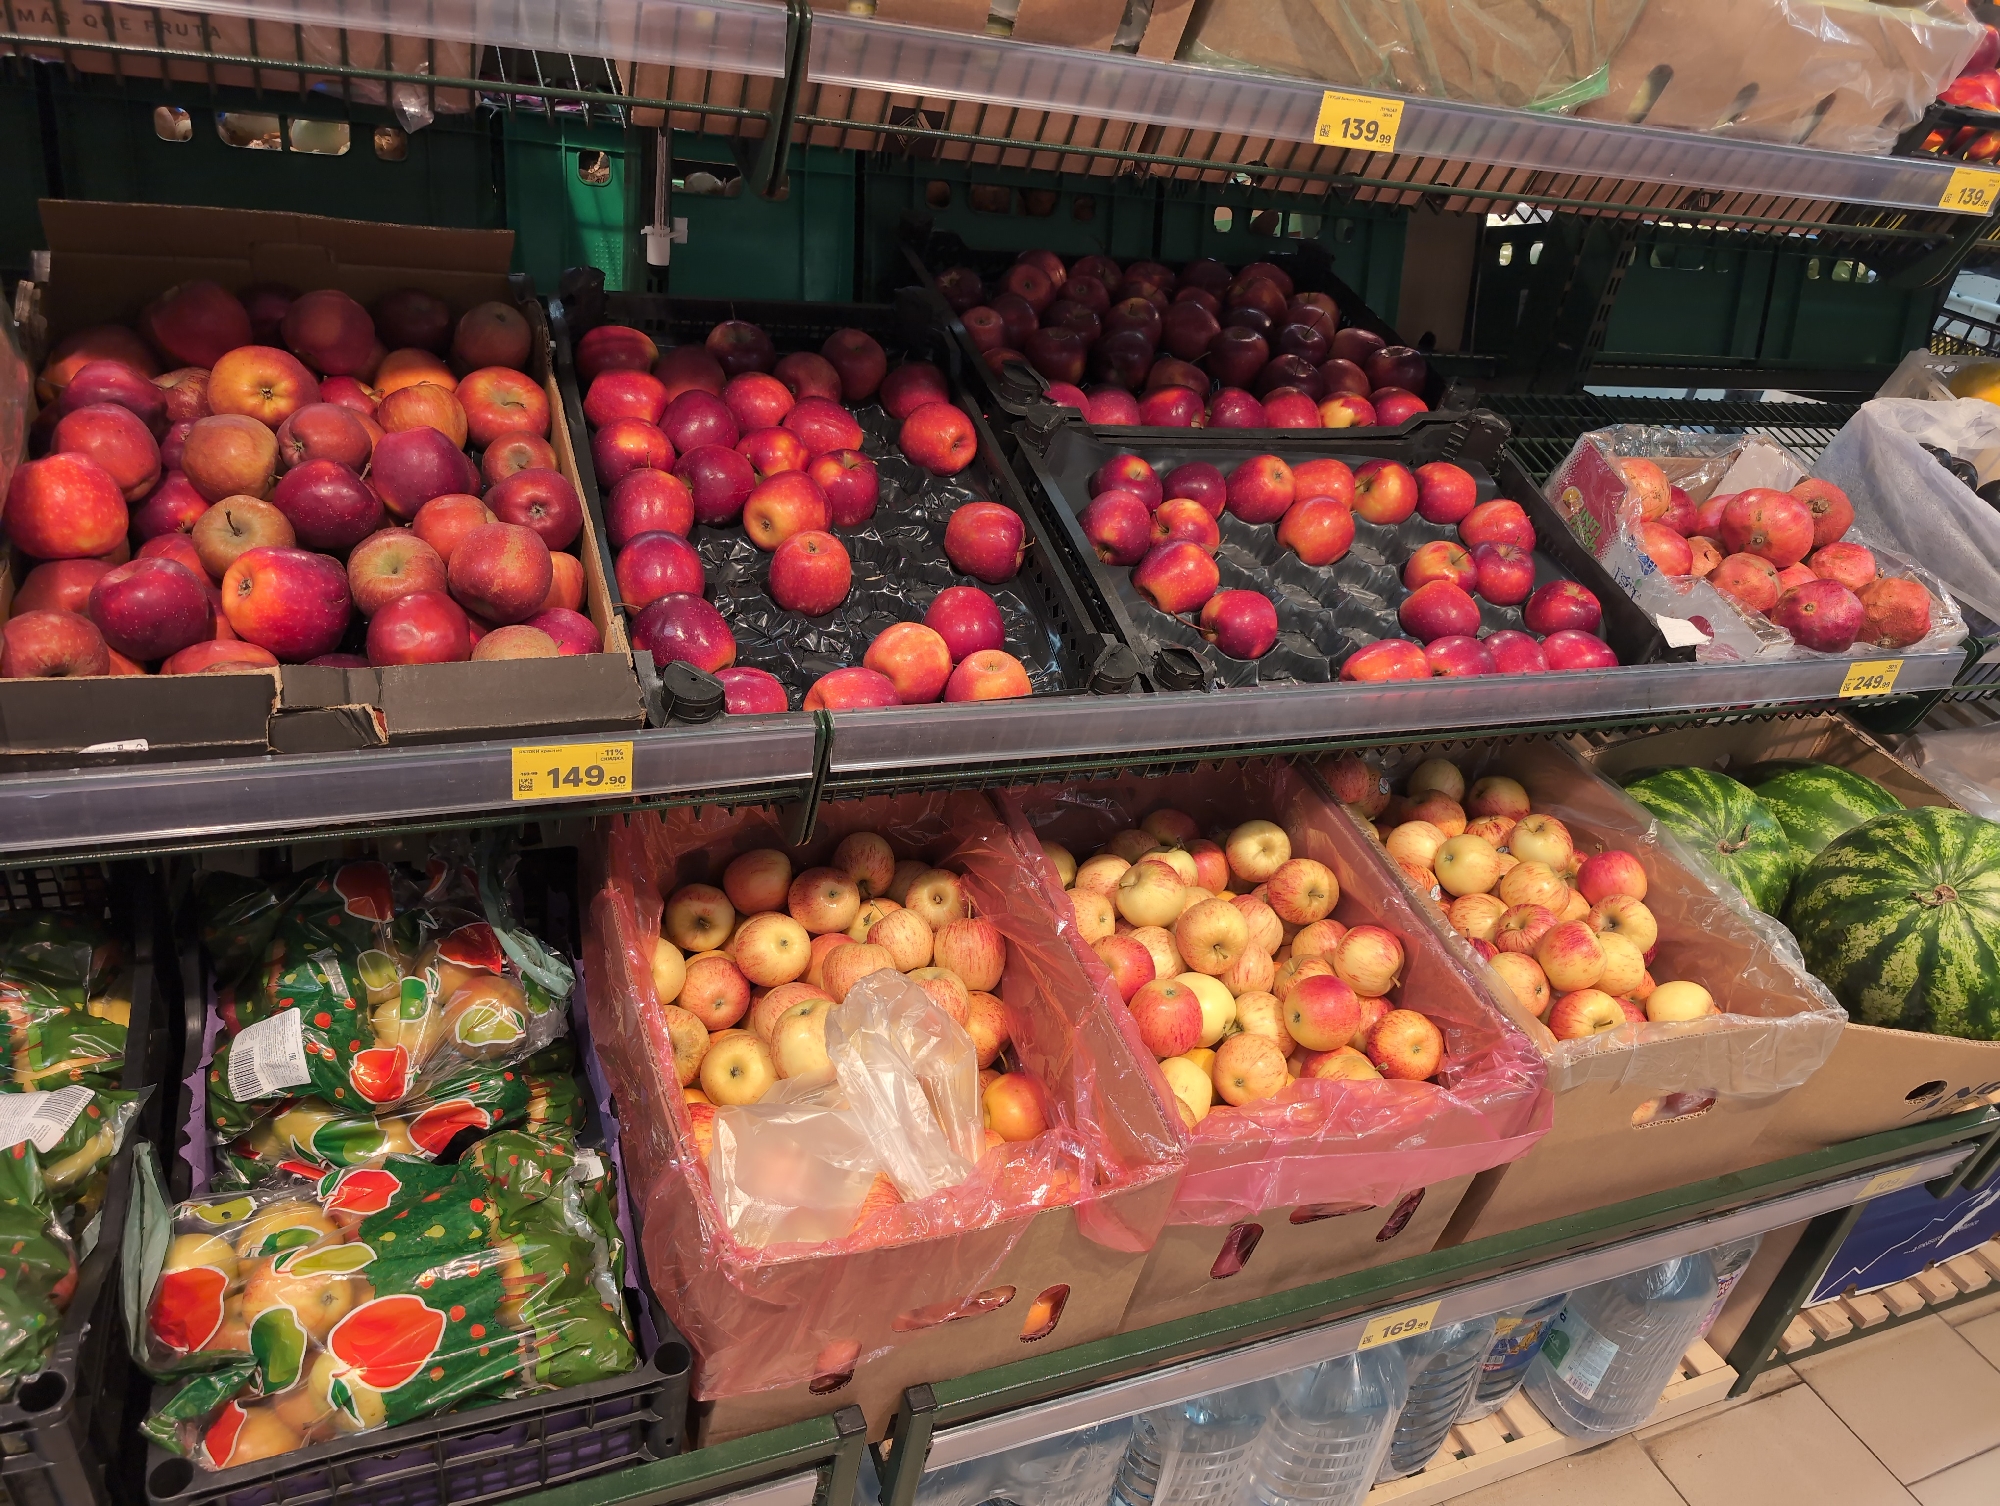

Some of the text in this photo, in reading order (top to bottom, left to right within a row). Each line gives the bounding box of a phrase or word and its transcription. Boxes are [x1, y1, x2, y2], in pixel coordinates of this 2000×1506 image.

[83, 14, 131, 31] QE
[1342, 117, 1392, 144] 139.99
[1853, 675, 1891, 690] 249.99
[601, 748, 624, 756] -11%
[547, 764, 626, 789] 149.90
[1382, 1318, 1429, 1339] 169.99
